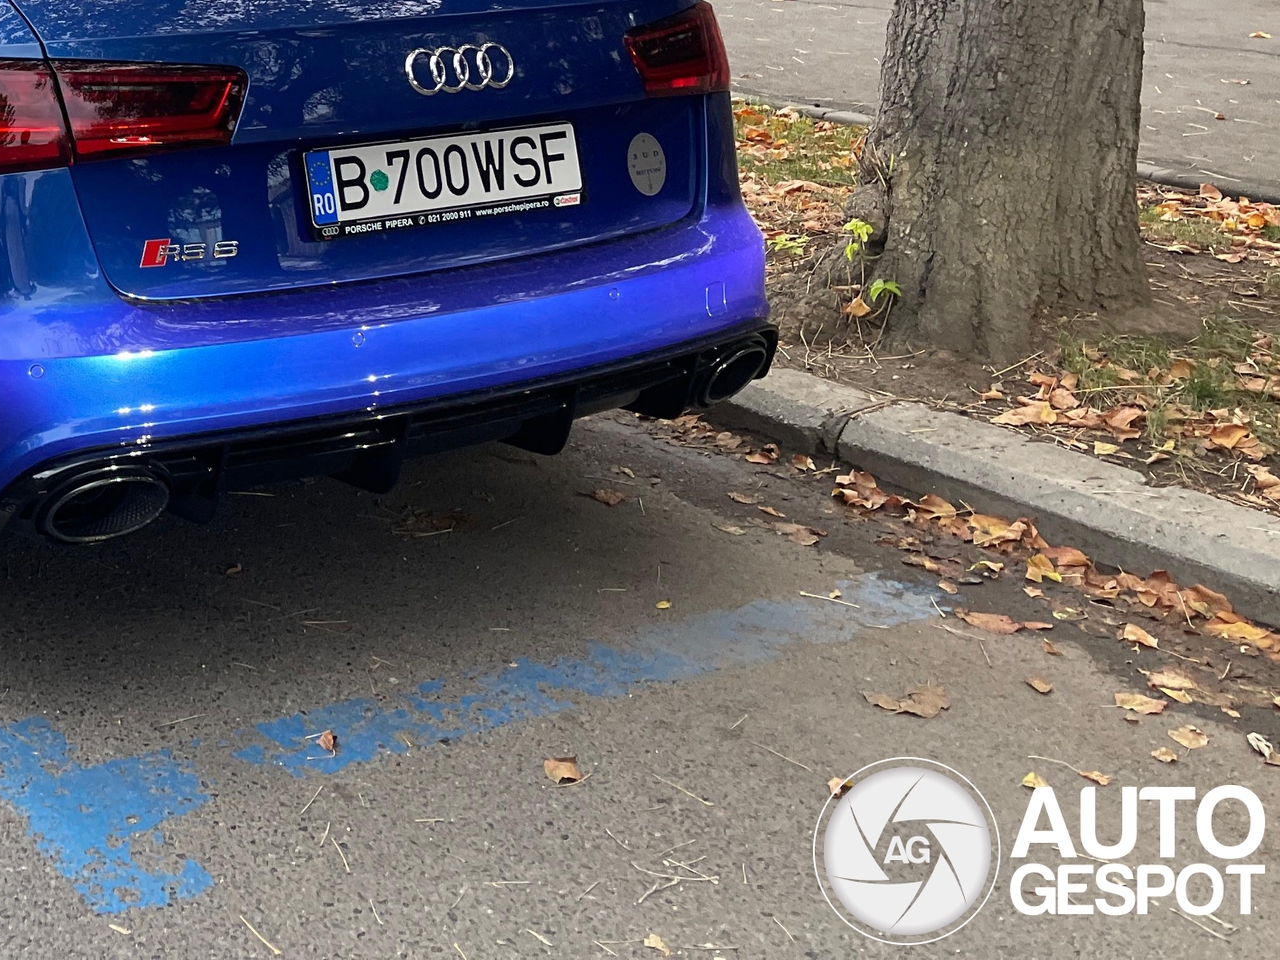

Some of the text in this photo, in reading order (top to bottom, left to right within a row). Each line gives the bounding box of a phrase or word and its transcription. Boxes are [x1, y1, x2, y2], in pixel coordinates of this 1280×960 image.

[334, 155, 370, 212] B
[313, 192, 335, 216] RO
[560, 196, 578, 205] Castrol
[345, 200, 550, 234] PORSCHE PIPERA 021 2000 911 www.porschepipera.ro
